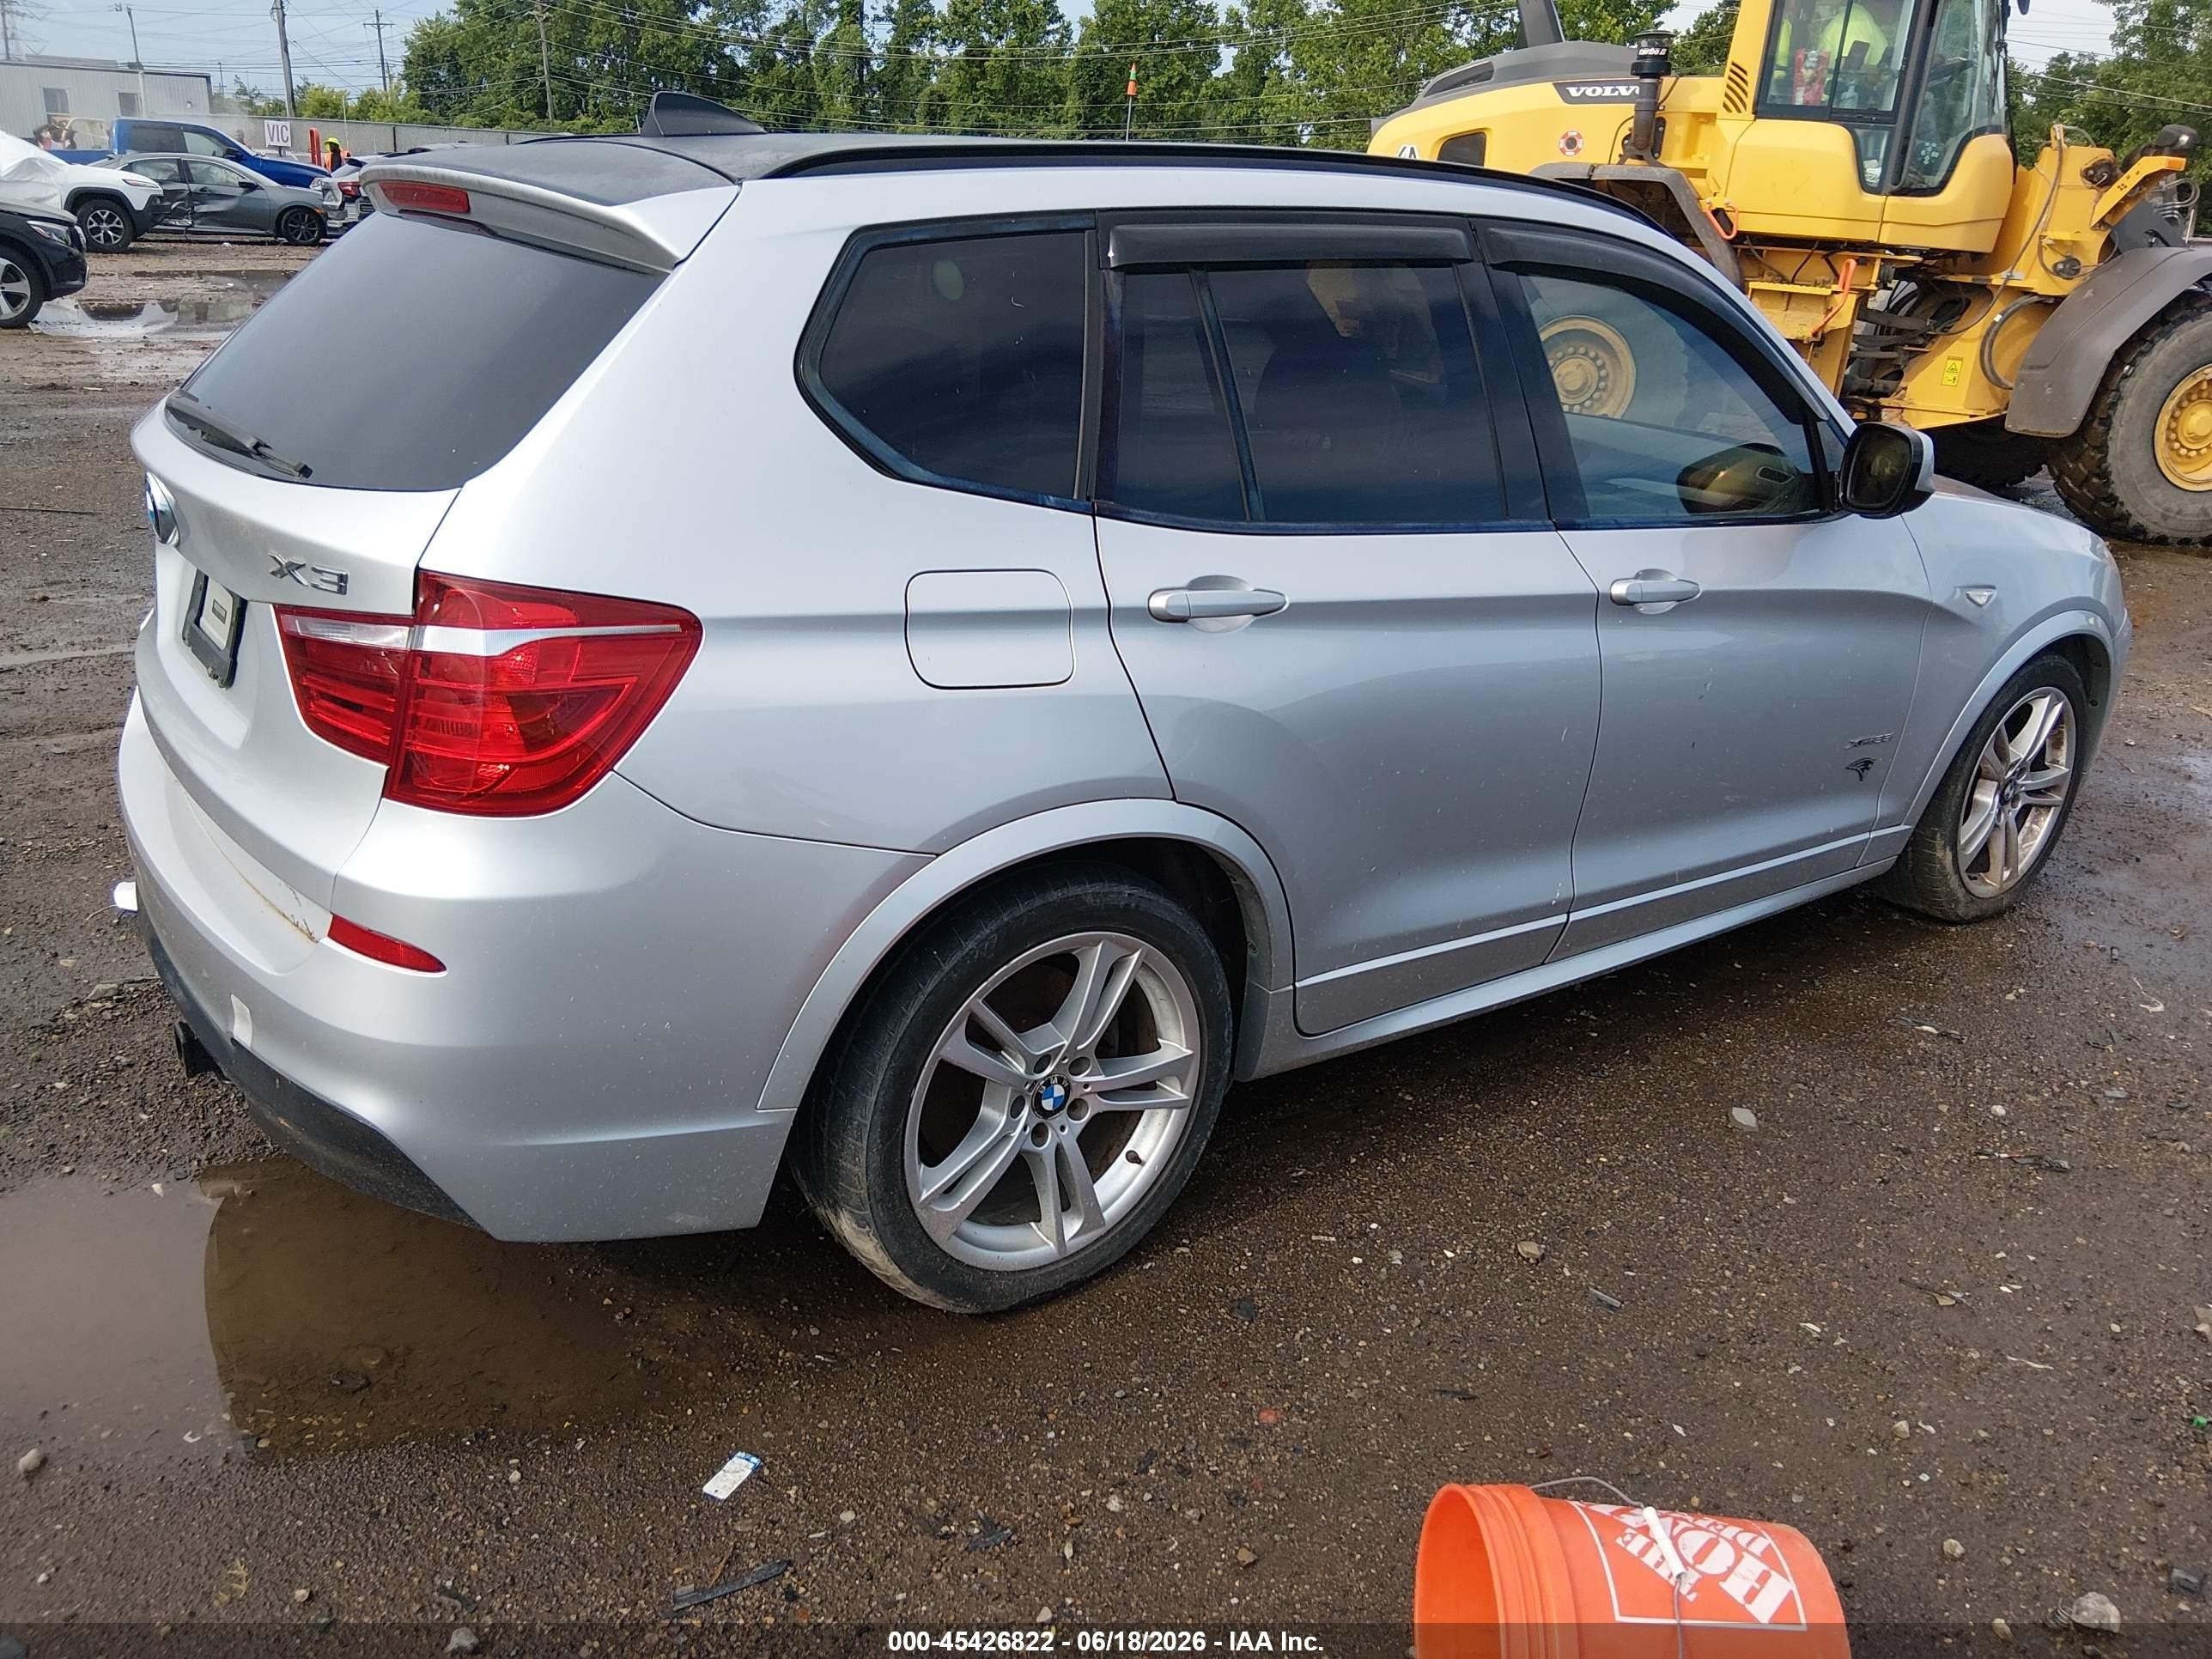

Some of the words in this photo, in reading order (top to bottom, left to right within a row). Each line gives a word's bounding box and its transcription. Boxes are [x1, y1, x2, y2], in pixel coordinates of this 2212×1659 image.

[1565, 85, 1640, 97] VOLV
[266, 123, 289, 143] VIC
[267, 551, 349, 595] X3
[1037, 1075, 1069, 1094] BMW
